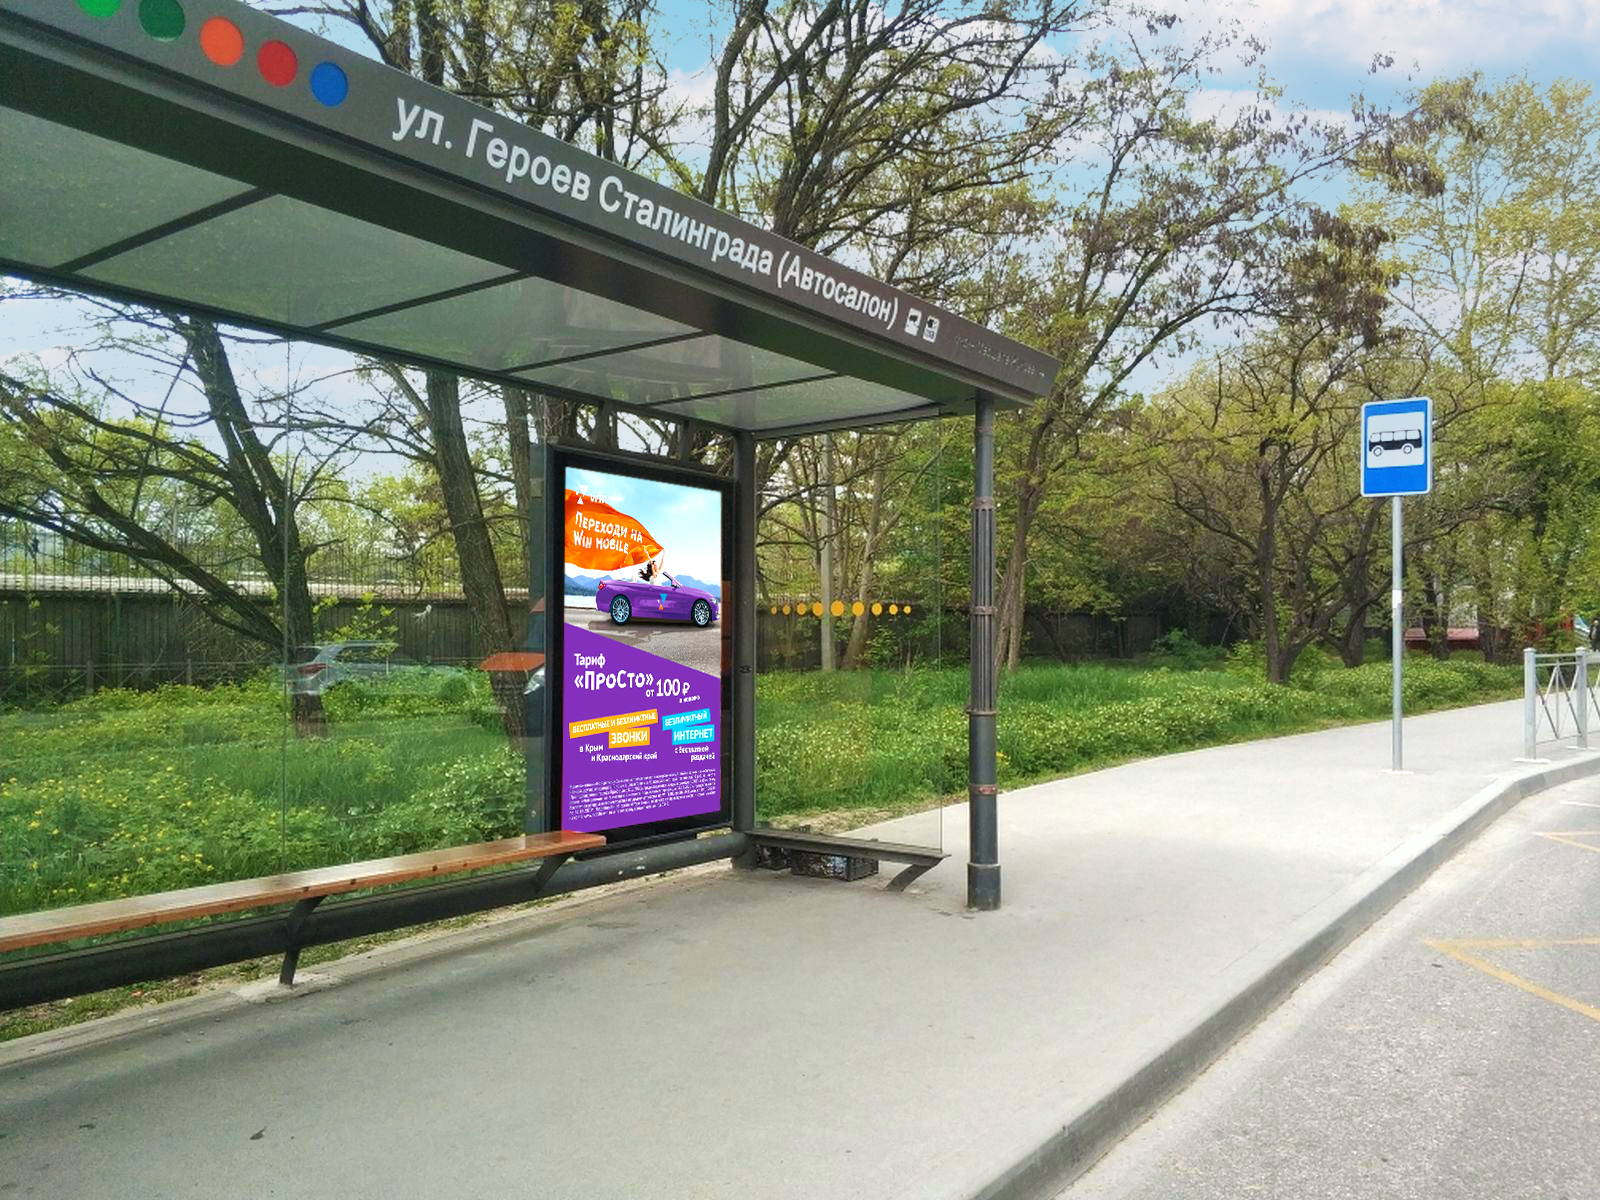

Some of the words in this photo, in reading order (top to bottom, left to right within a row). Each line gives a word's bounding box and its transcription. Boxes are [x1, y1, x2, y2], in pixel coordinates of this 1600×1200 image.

[391, 97, 453, 150] ул.
[465, 118, 592, 202] Героев
[599, 175, 773, 276] Сталинграда
[776, 250, 899, 330] (Автосалон)
[573, 653, 606, 669] Тариф
[656, 678, 681, 697] 100
[610, 730, 648, 745] ЗВОНКИ
[673, 727, 714, 742] ИНТЕРНЕТ
[585, 743, 604, 754] Крым
